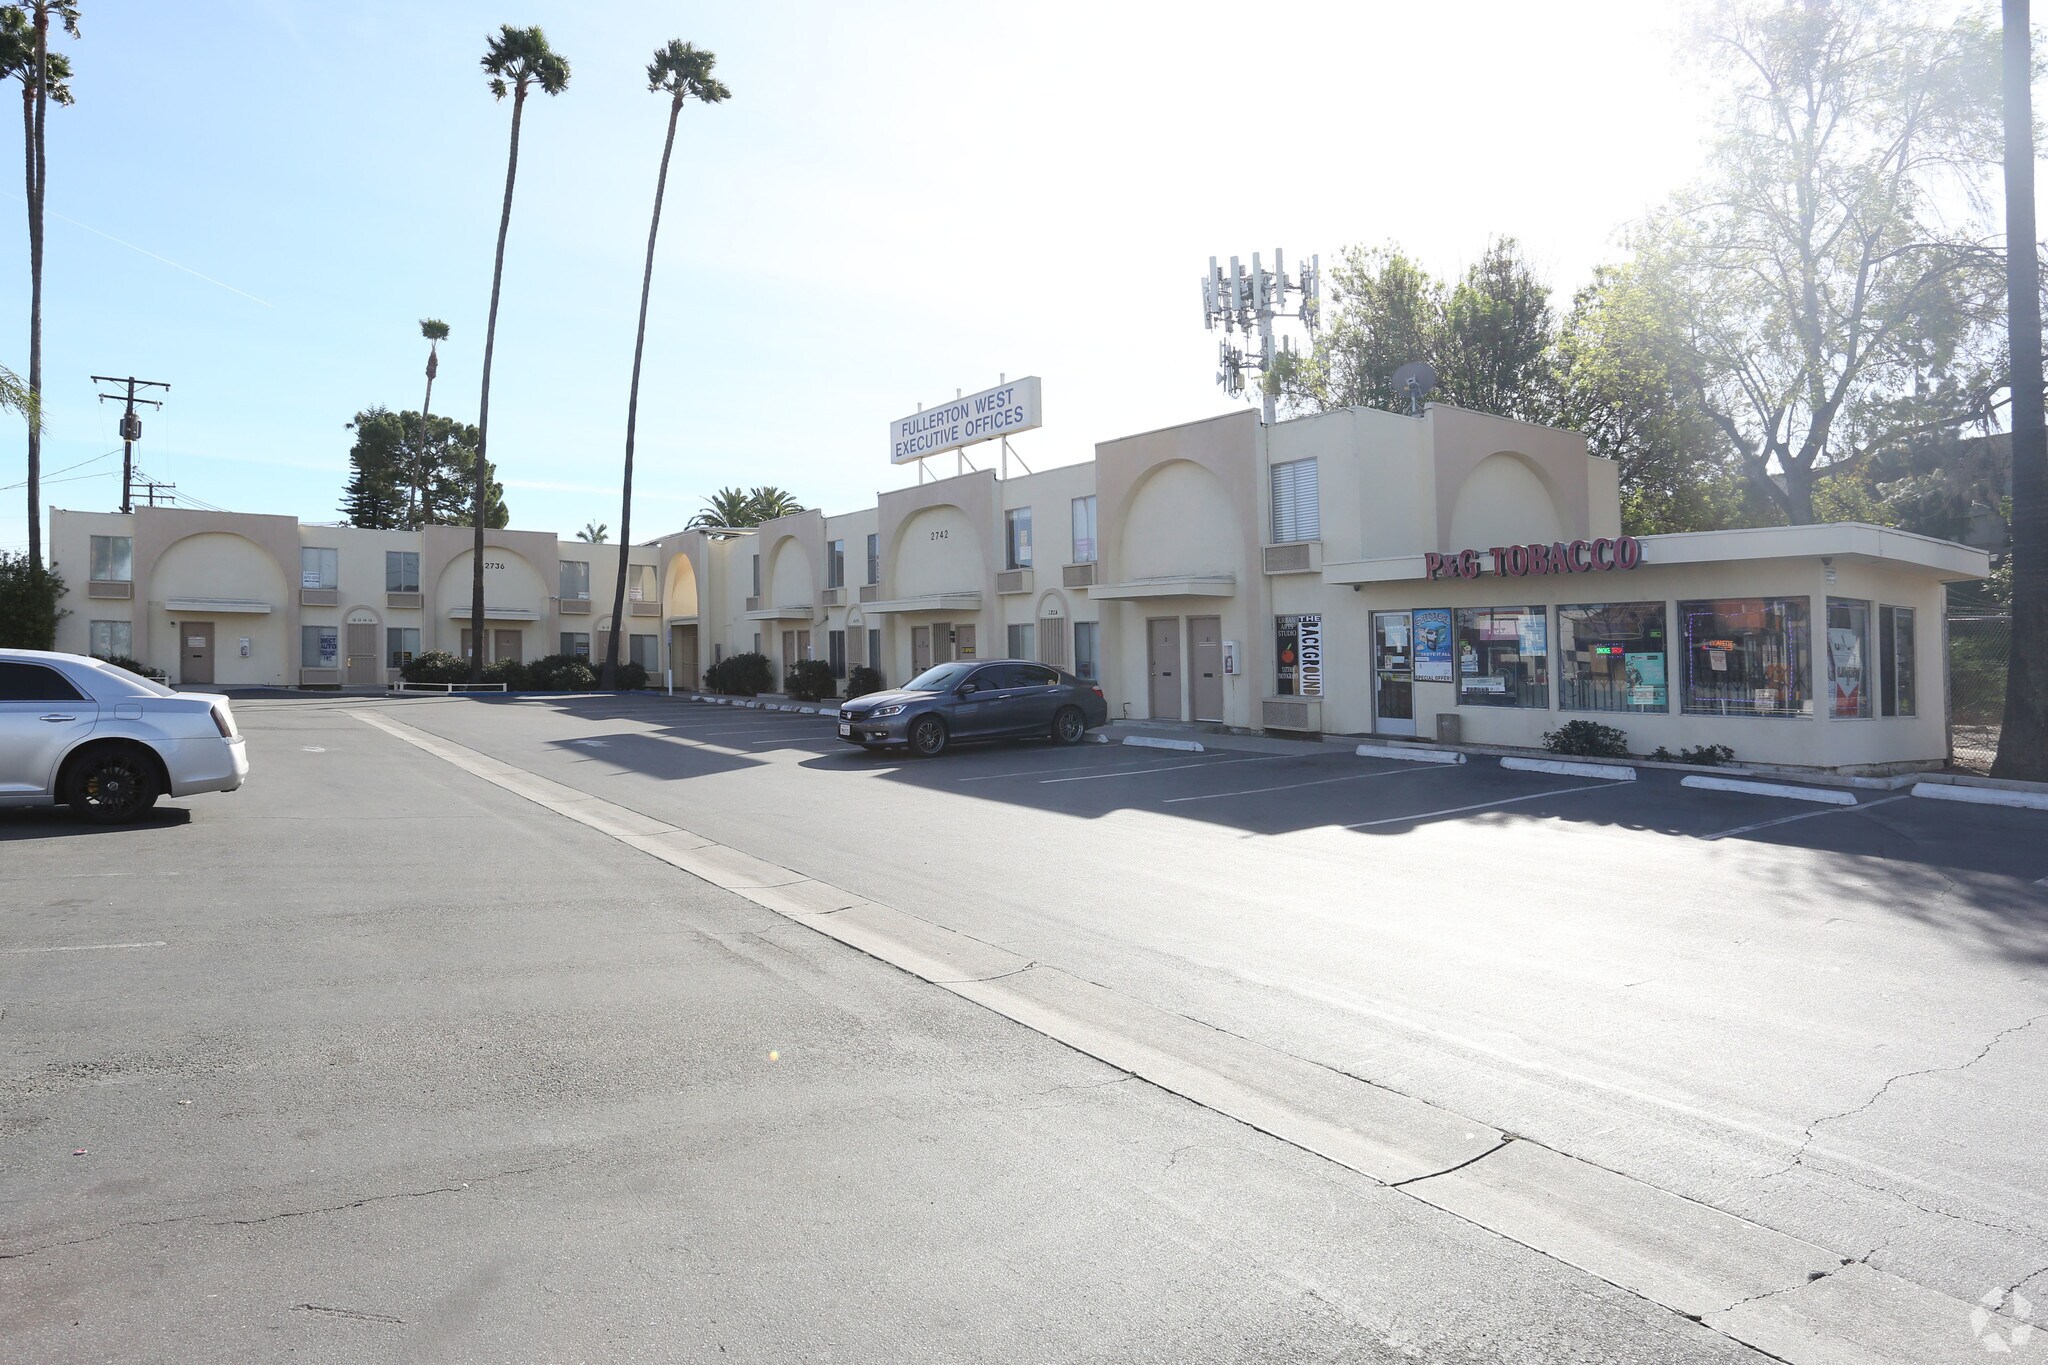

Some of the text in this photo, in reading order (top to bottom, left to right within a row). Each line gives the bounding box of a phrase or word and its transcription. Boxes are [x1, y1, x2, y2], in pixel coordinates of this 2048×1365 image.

[896, 405, 1024, 456] EXECUTIVE OFFICES
[902, 388, 1014, 437] FULLERTON WEST
[930, 529, 949, 541] 2742
[484, 562, 505, 570] 2736
[1424, 536, 1642, 581] P&G TOBACCO
[1278, 629, 1297, 637] STUDIO
[1302, 622, 1321, 696] BACKGROUND
